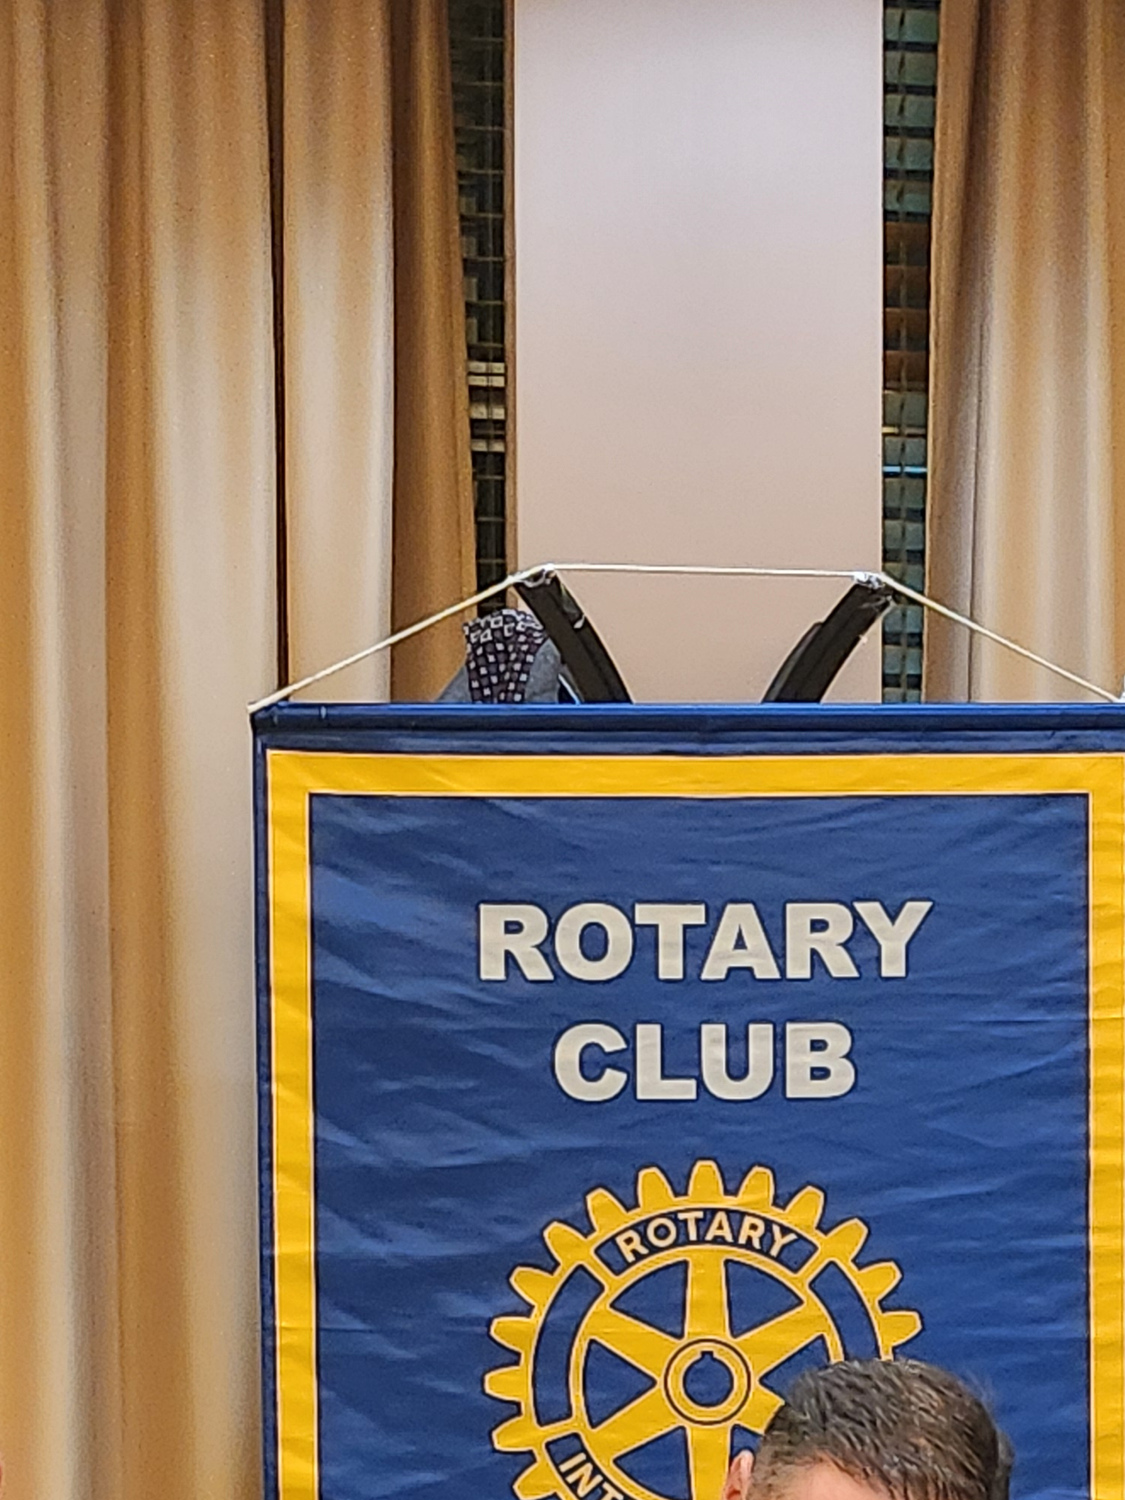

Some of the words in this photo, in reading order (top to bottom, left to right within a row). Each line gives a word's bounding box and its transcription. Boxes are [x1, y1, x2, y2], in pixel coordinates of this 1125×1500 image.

[478, 901, 934, 981] ROTARY
[553, 1022, 856, 1102] CLUB
[614, 1210, 799, 1263] ROTARY
